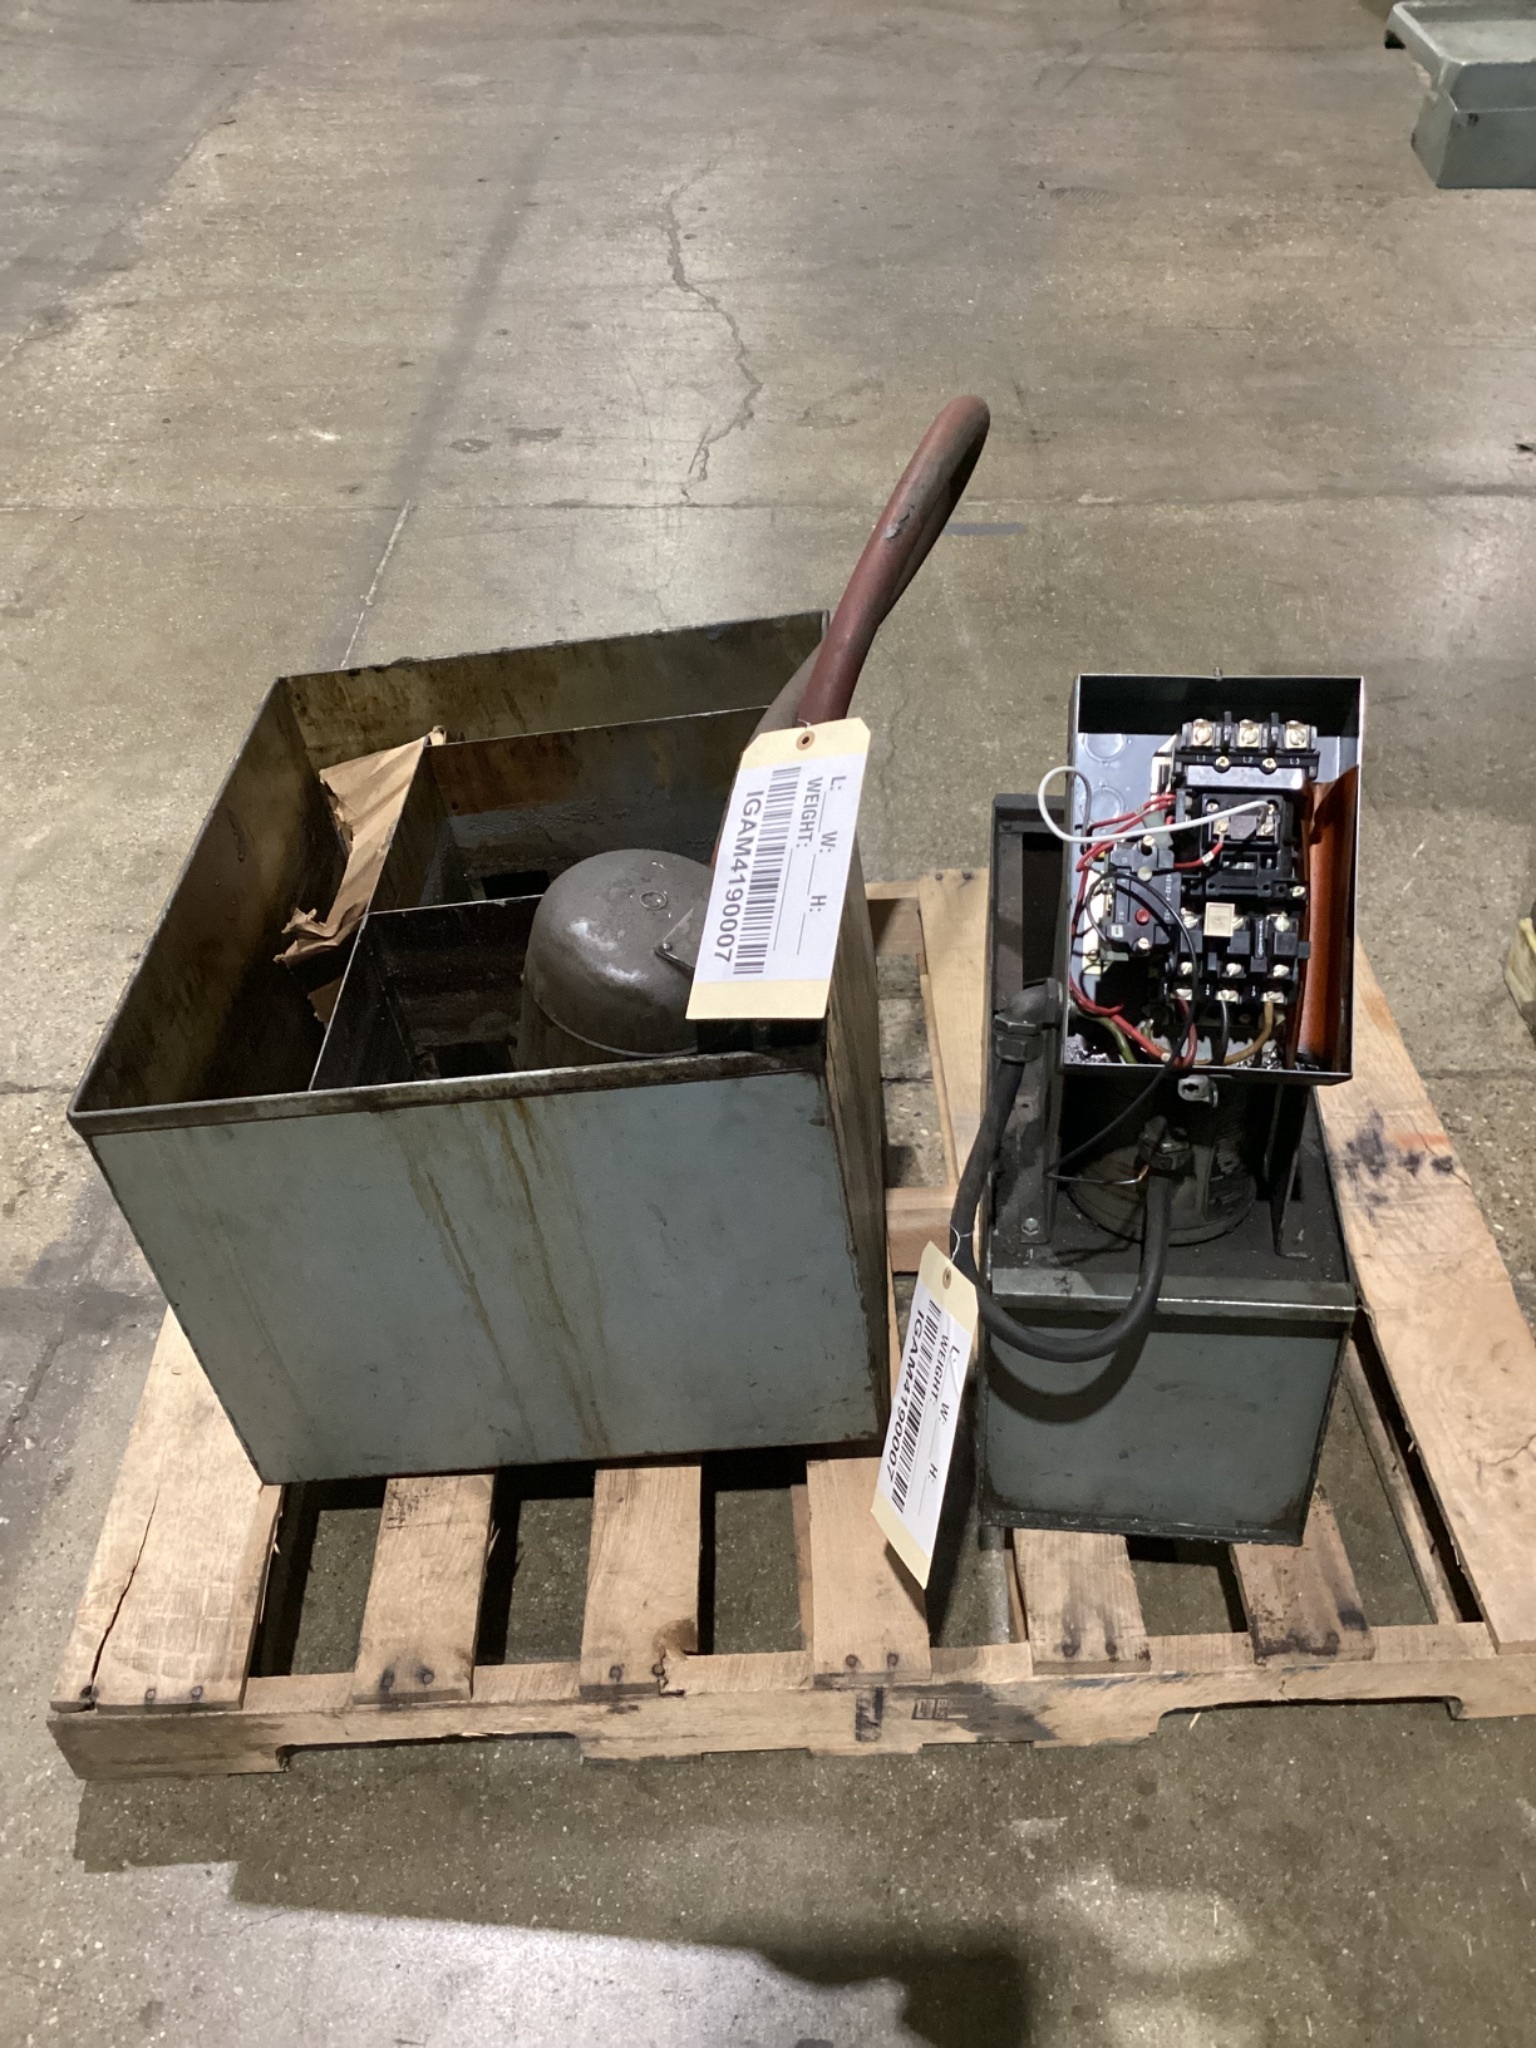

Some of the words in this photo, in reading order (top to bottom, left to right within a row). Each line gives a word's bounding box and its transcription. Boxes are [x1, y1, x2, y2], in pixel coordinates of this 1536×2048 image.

[1242, 756, 1253, 764] L2
[829, 775, 848, 791] L:
[795, 776, 824, 849] WEIGHT:
[818, 831, 838, 854] W:
[713, 790, 765, 963] IGAM4190007
[808, 894, 828, 913] H:
[928, 1334, 949, 1405] WEIGHT:
[885, 1309, 926, 1484] IGAM4190007
[937, 1402, 951, 1426] W:
[926, 1462, 939, 1483] H:
